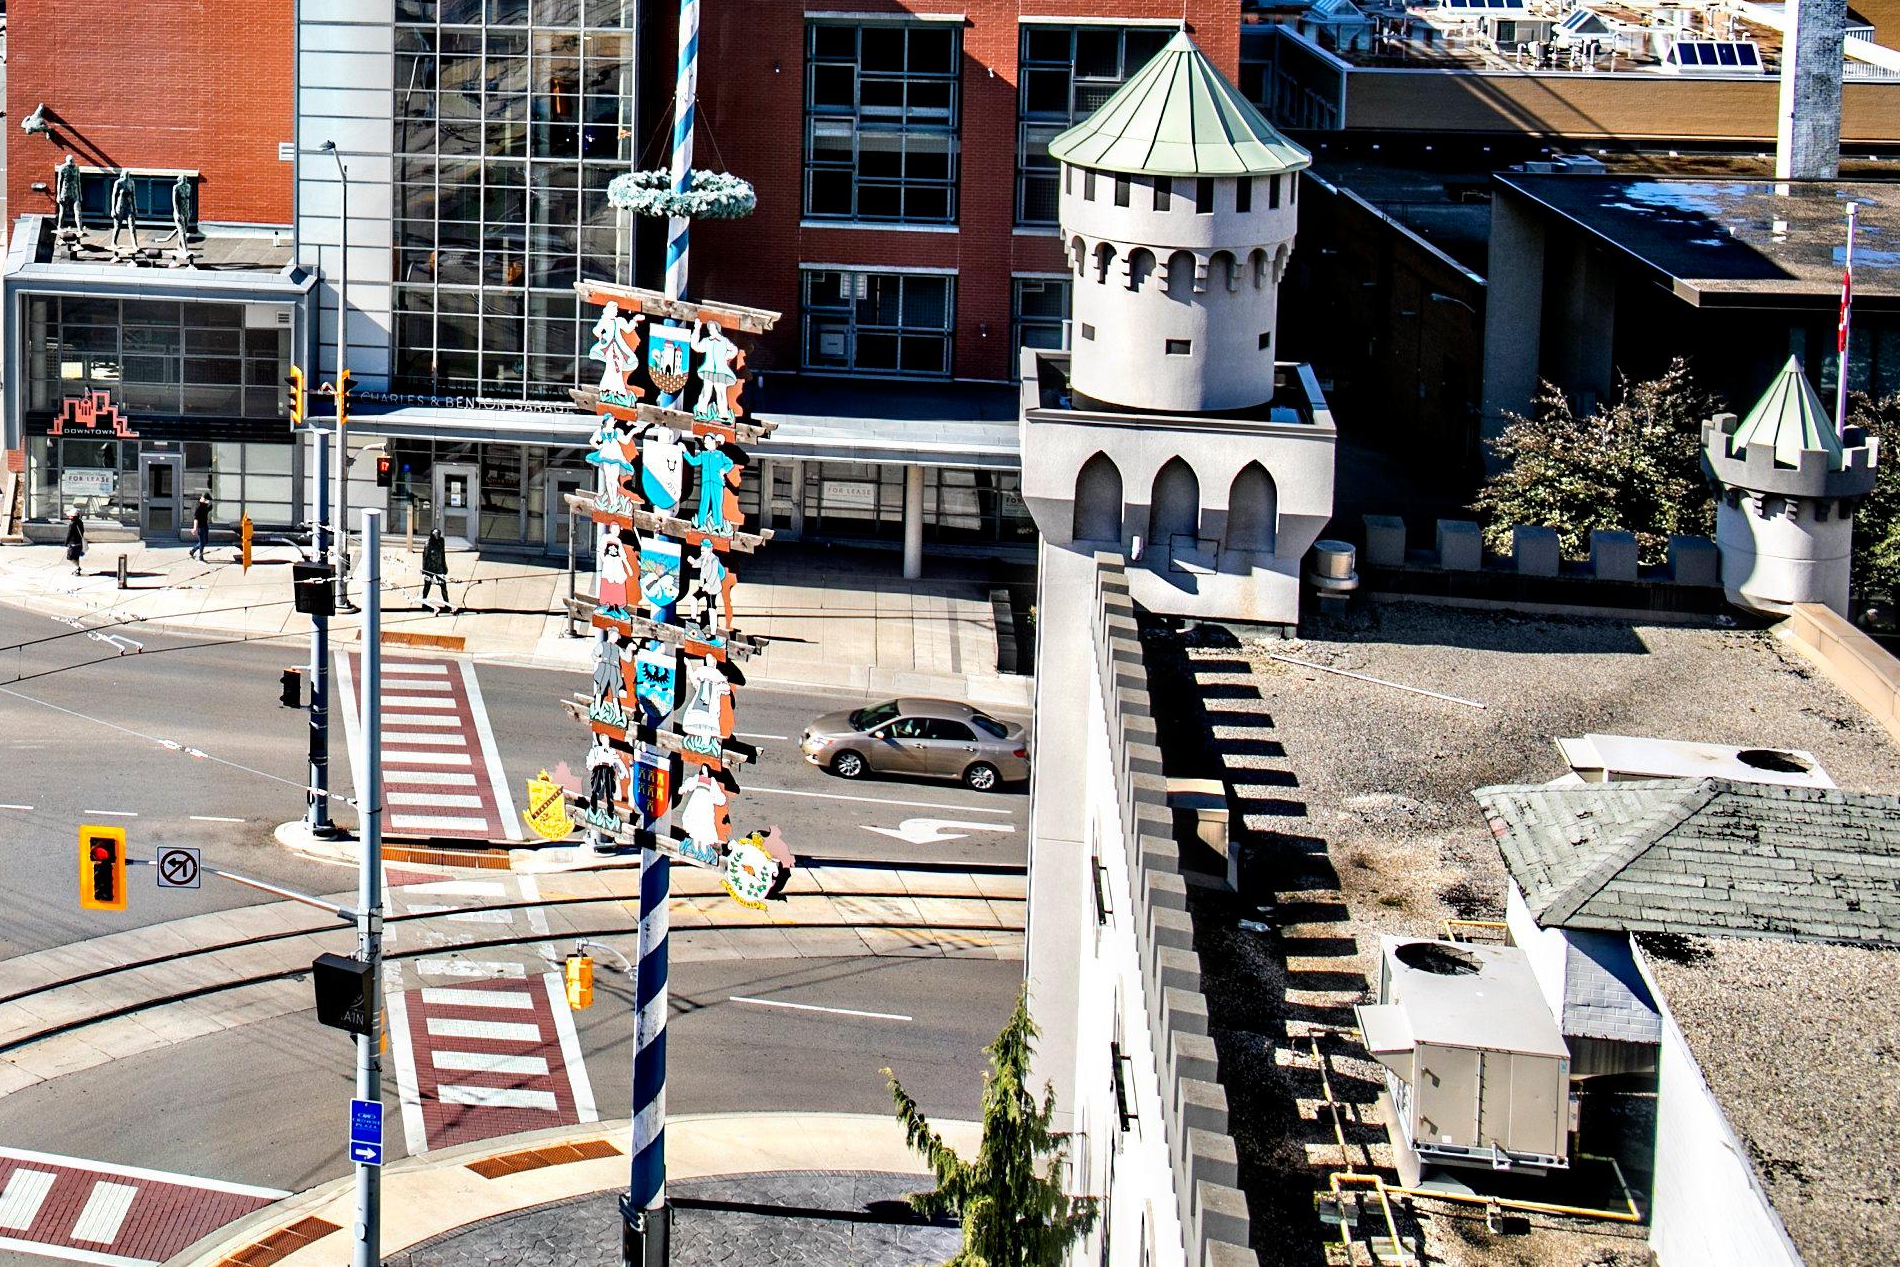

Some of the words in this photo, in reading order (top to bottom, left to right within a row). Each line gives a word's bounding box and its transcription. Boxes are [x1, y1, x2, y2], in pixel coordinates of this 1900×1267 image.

[360, 391, 424, 407] CHARLES
[430, 395, 440, 407] &
[445, 396, 506, 411] BENTON
[86, 475, 110, 483] LEASE
[846, 487, 871, 495] LEASE
[341, 1010, 364, 1026] AIN
